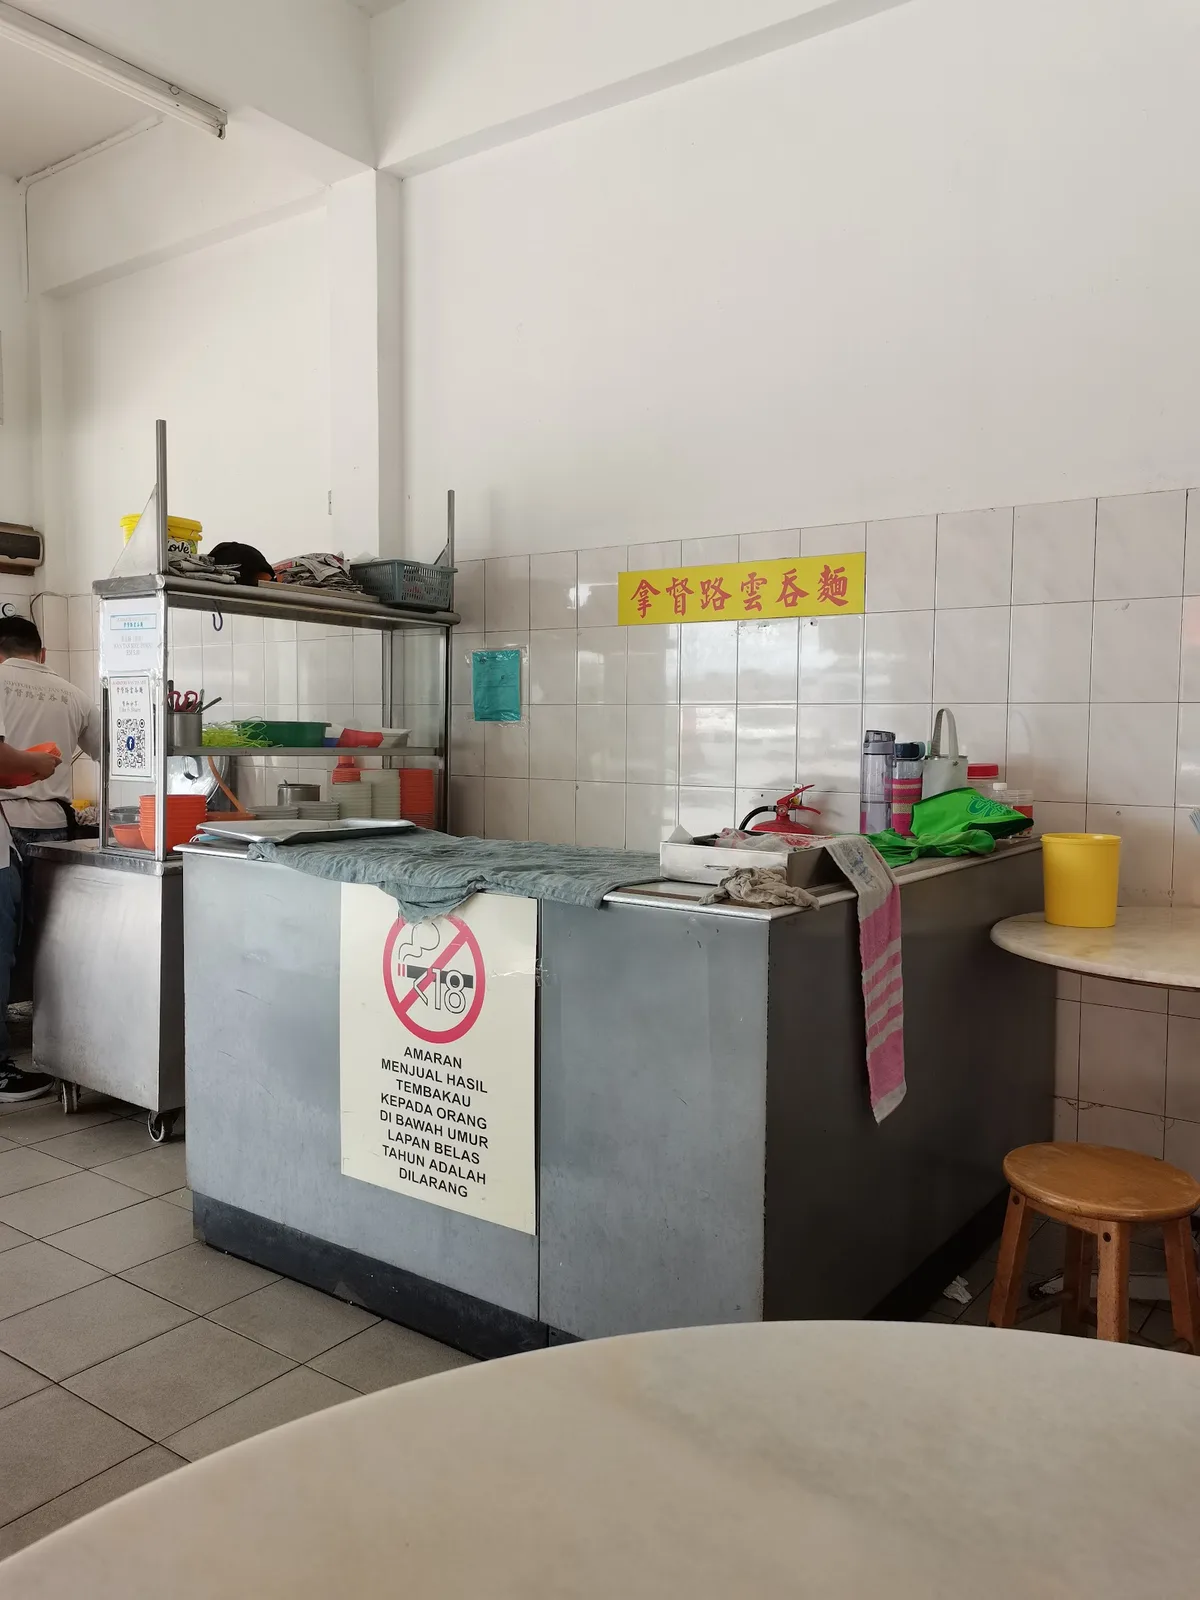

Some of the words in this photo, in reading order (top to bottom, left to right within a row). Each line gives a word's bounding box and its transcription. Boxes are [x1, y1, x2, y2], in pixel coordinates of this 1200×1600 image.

[167, 541, 189, 555] ove
[404, 1046, 462, 1069] AMARAN
[381, 1058, 442, 1083] MENJUAL
[446, 1073, 488, 1093] HASIL
[396, 1079, 471, 1107] TEMBAKAU
[380, 1092, 433, 1116] KEPADA
[436, 1107, 487, 1130] ORANG
[380, 1109, 392, 1123] DI
[395, 1114, 443, 1137] BAWAH
[447, 1127, 489, 1149] UMUR
[387, 1129, 430, 1151] LAPAN
[434, 1142, 480, 1164] BELAS
[382, 1144, 425, 1167] TAHUN
[429, 1159, 486, 1185] ADALAH
[399, 1167, 468, 1198] DILARANG
